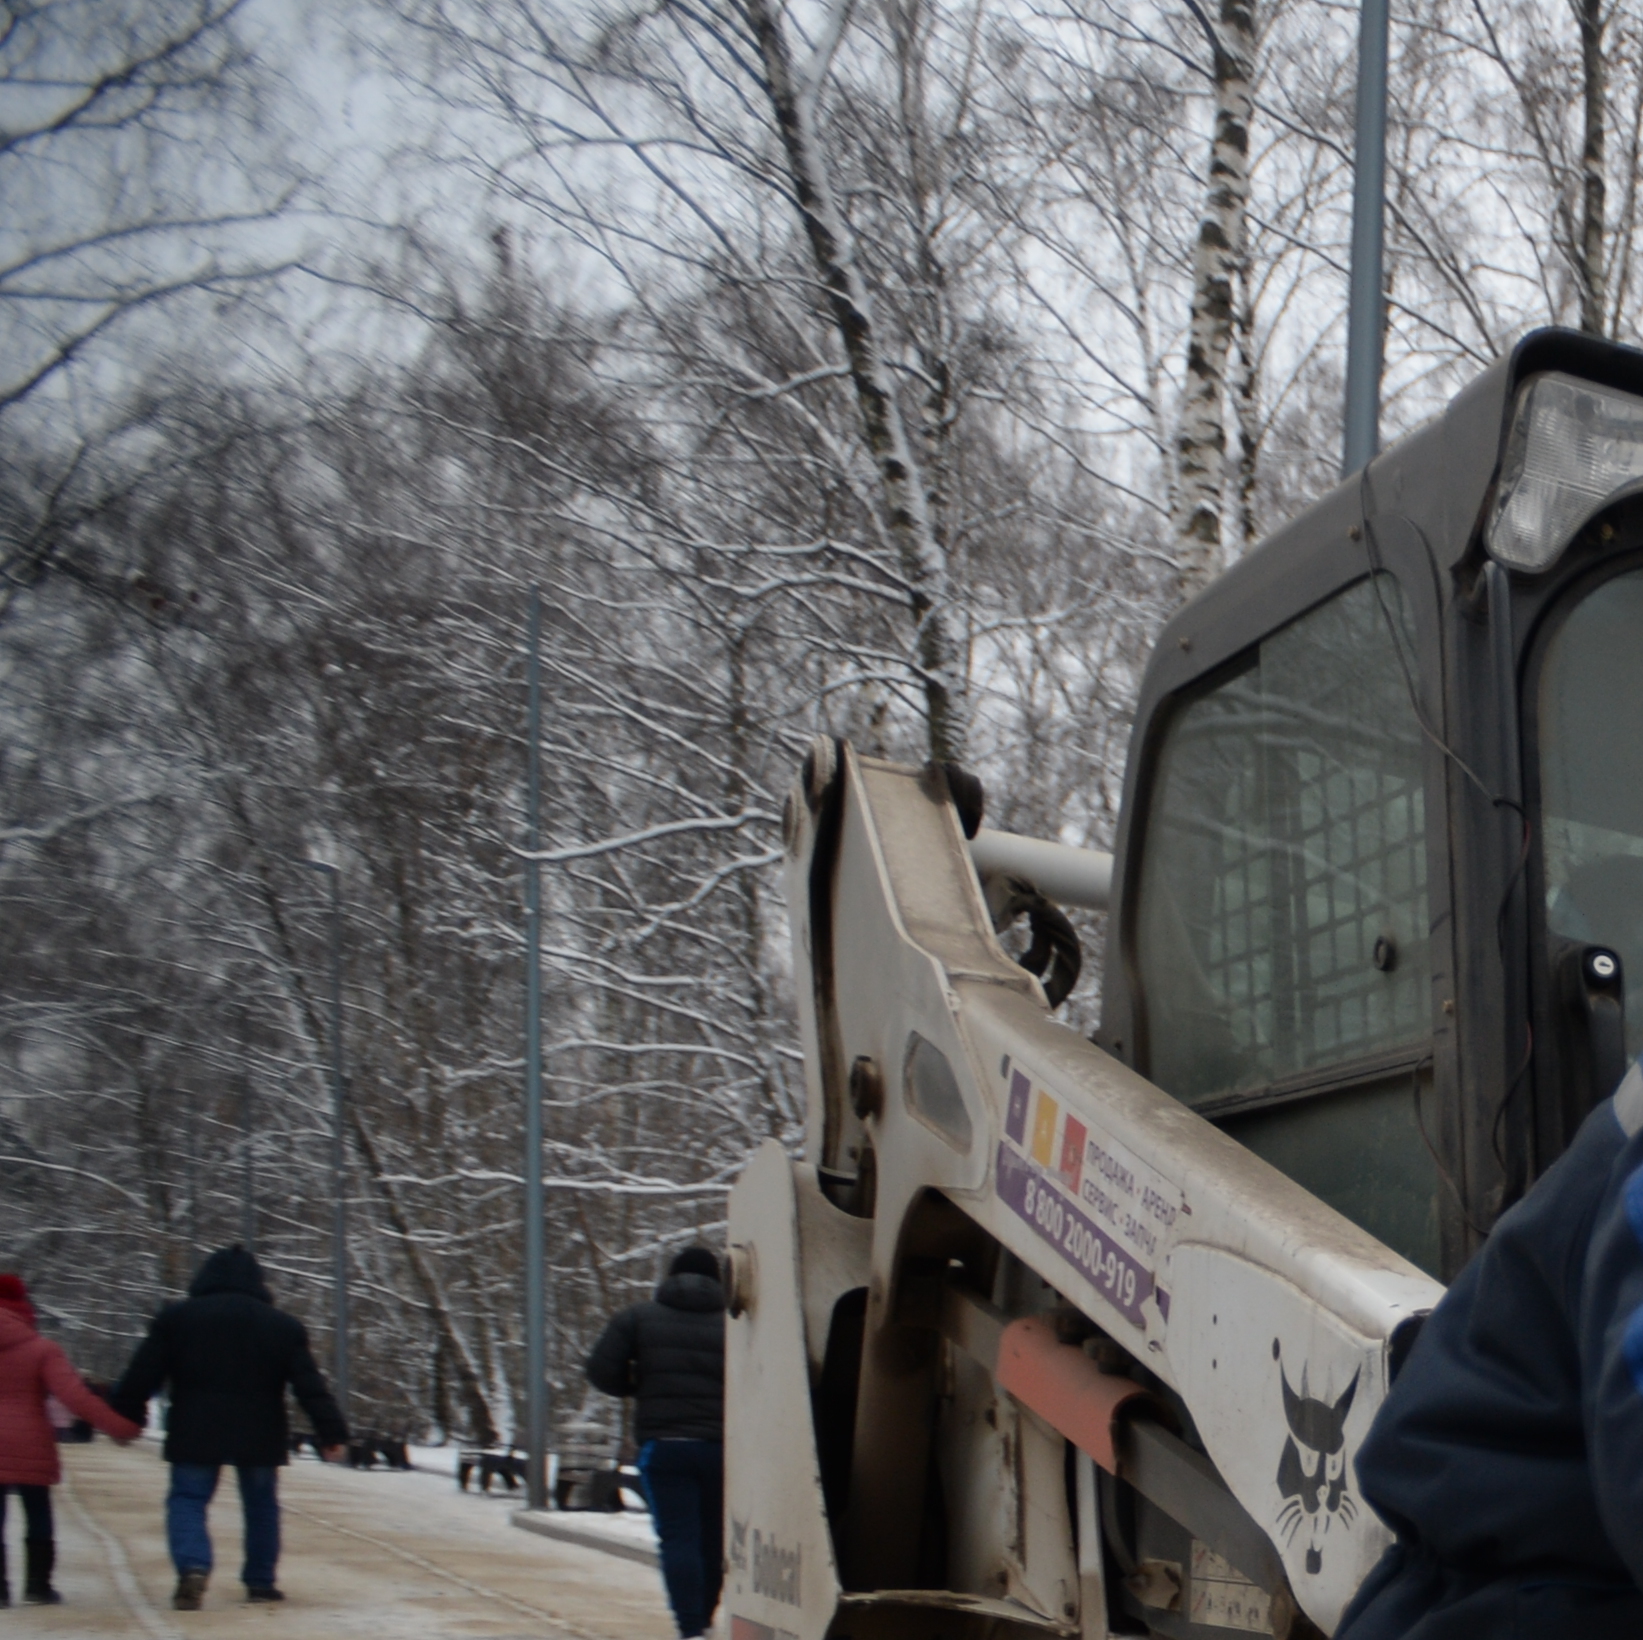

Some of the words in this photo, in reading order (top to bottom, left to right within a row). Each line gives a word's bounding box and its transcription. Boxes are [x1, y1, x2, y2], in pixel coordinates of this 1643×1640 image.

[1083, 1179, 1118, 1225] СЕРВИС
[1086, 1140, 1135, 1197] ПРОДАЖА
[1024, 1178, 1036, 1215] 8
[1035, 1189, 1063, 1240] 800
[1063, 1213, 1136, 1307] 2000-919
[753, 1528, 801, 1608] Bobcat
